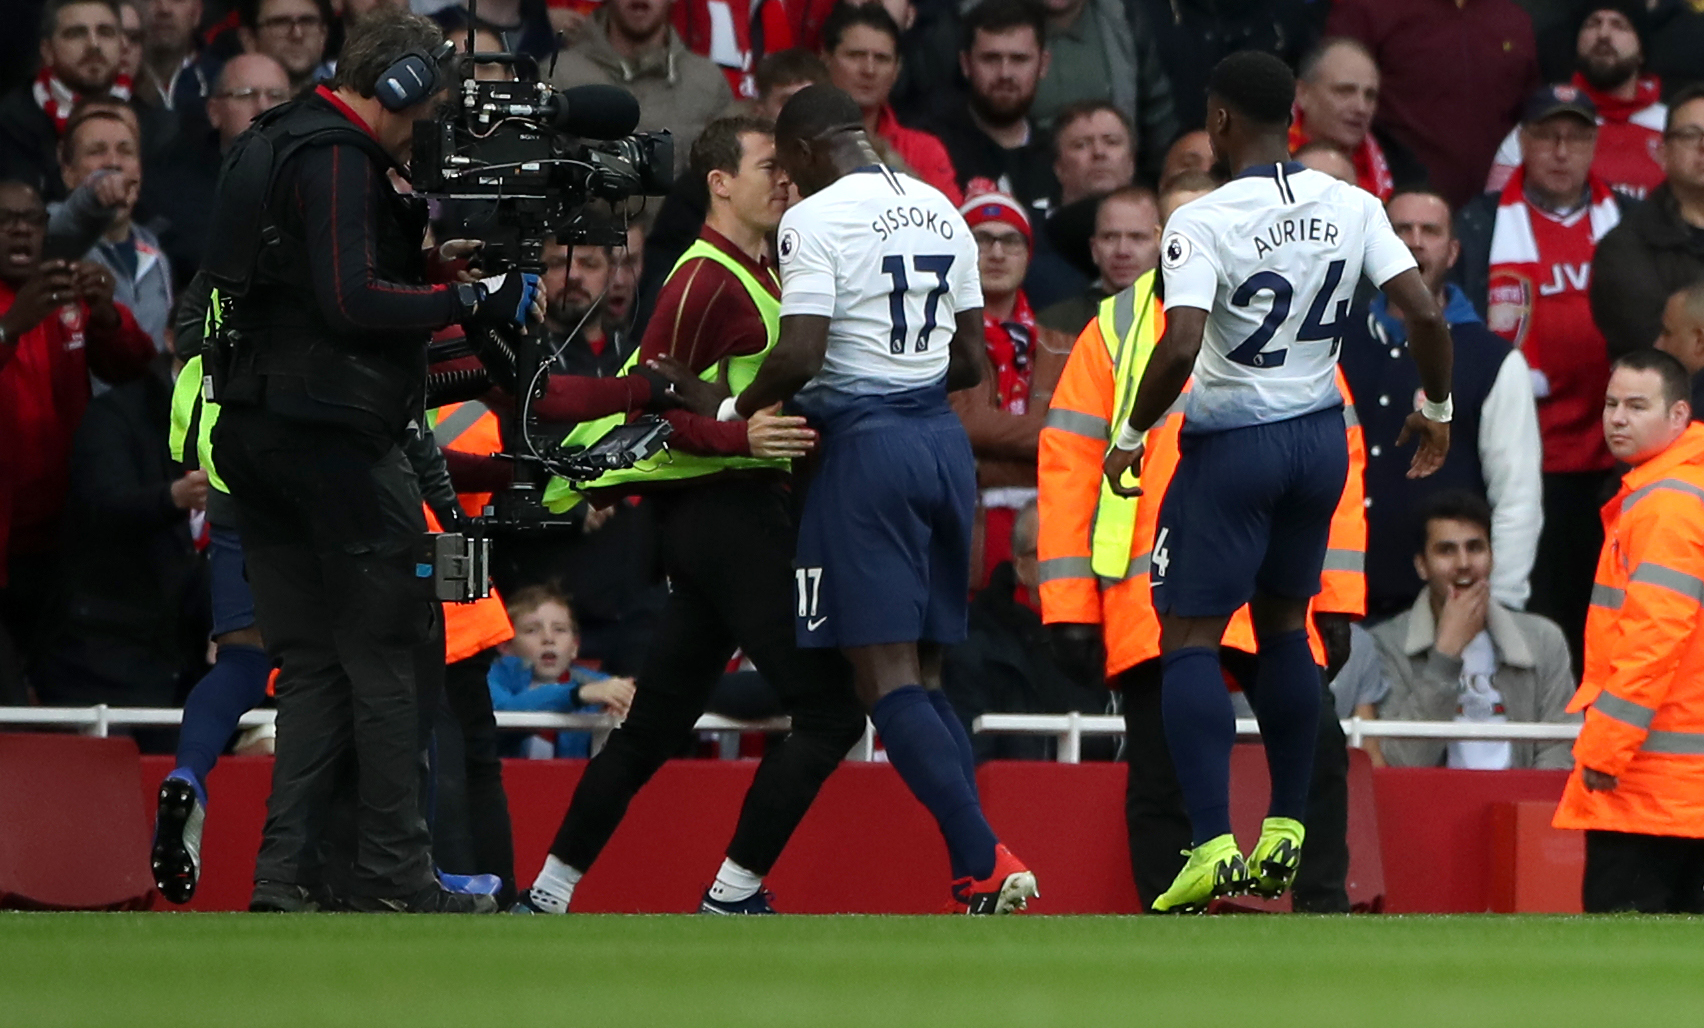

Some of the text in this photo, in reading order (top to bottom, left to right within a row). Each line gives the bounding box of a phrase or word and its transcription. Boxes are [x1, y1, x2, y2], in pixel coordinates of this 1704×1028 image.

[872, 206, 953, 241] SISSOKO
[1253, 218, 1338, 260] AURIER
[1539, 262, 1592, 296] JV
[881, 254, 955, 354] 17
[1226, 259, 1350, 368] 24
[795, 567, 823, 617] 17
